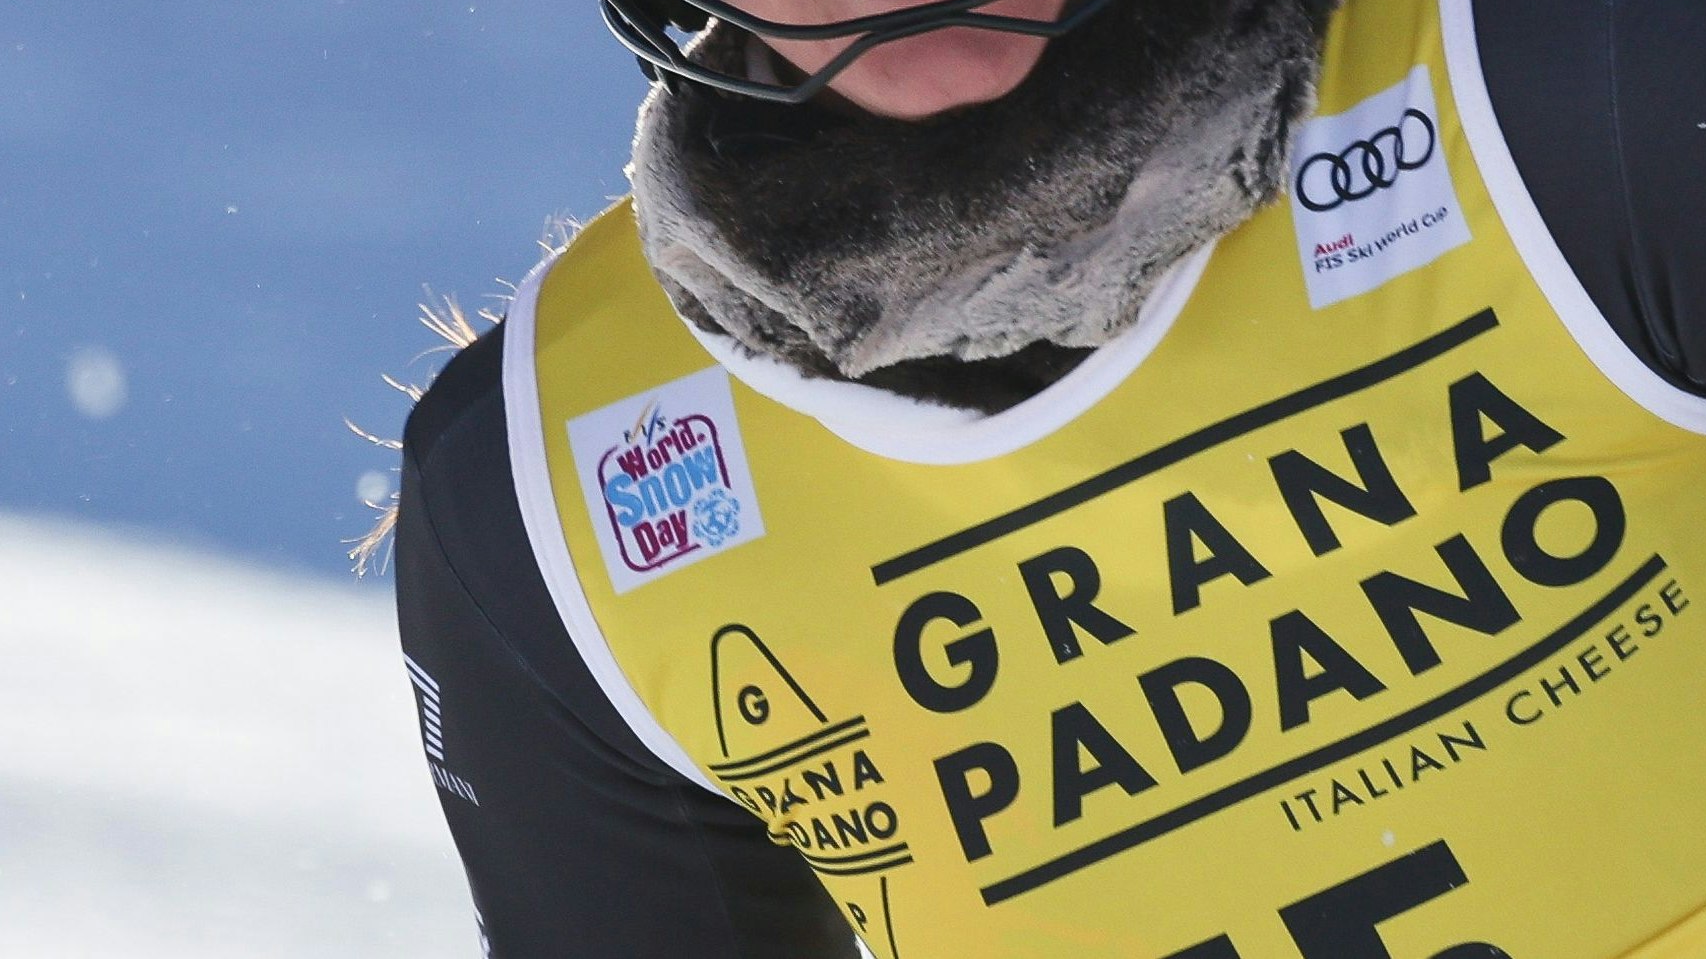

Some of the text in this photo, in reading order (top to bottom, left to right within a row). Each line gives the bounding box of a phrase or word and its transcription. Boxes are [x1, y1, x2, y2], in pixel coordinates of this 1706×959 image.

[1315, 206, 1448, 273] FIS Ski World Cup
[1315, 234, 1354, 256] Audi
[633, 509, 688, 562] Day
[892, 370, 1567, 715] GRANA
[932, 474, 1628, 864] PADANO
[736, 684, 770, 725] G
[1279, 579, 1692, 832] ITALIAN CHEESE
